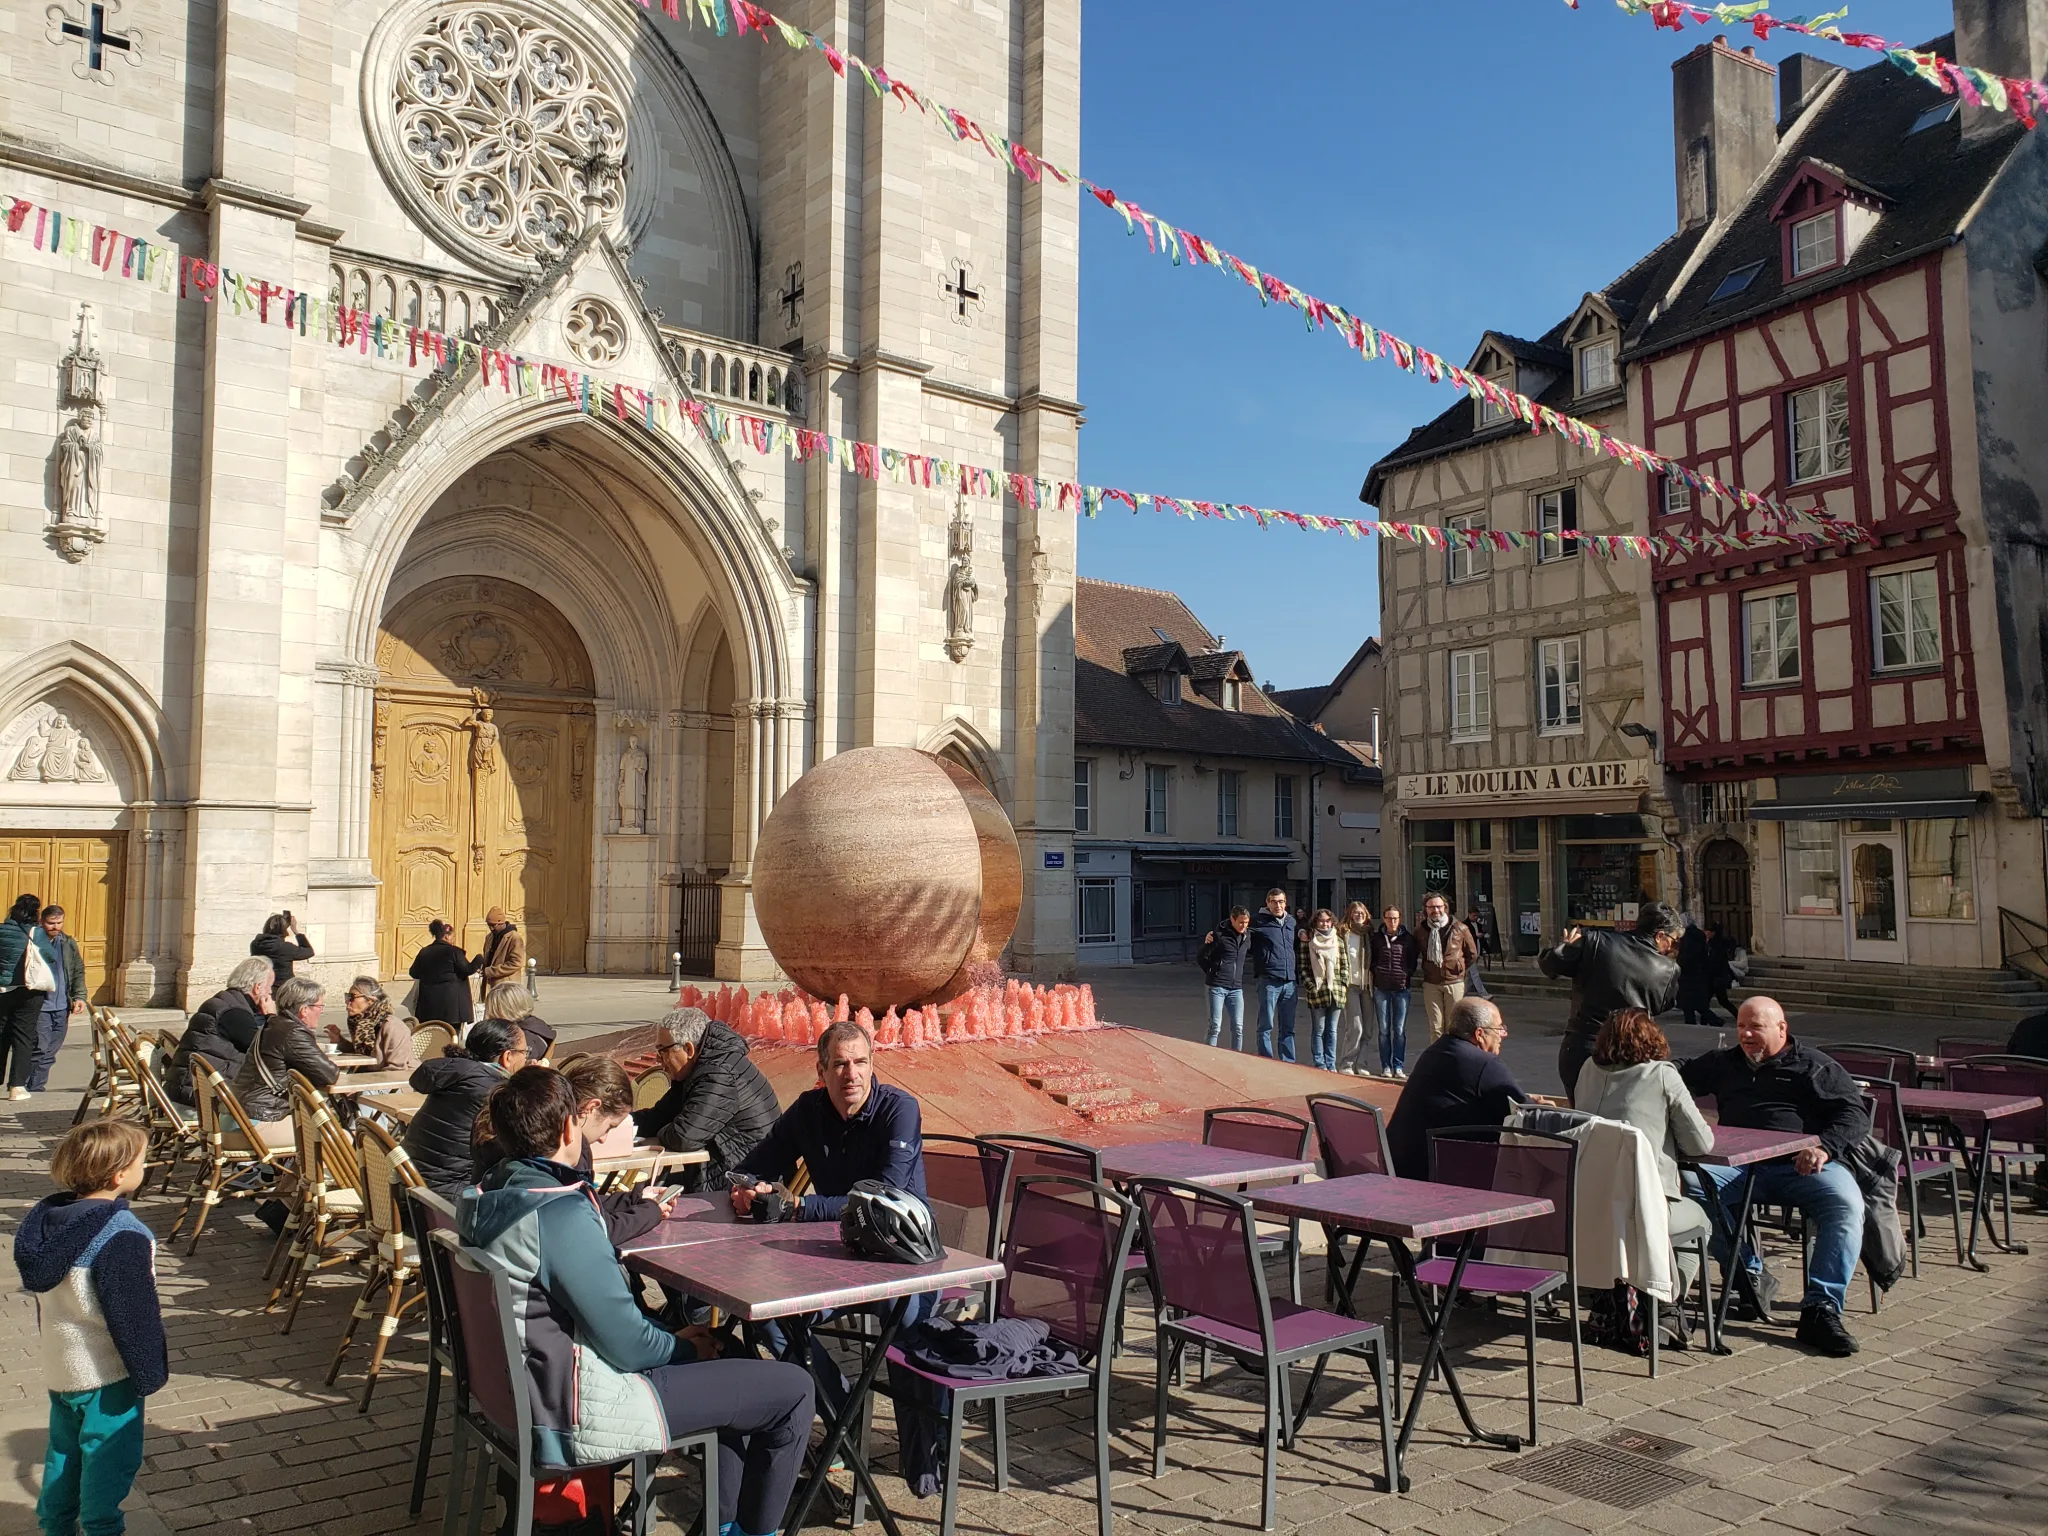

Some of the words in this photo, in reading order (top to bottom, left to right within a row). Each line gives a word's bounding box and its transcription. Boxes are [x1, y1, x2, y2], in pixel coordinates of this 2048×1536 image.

[1425, 776, 1449, 796] LE
[1455, 769, 1539, 794] MOULIN
[1546, 768, 1561, 789] A
[1567, 763, 1627, 788] CAFE
[1423, 869, 1449, 879] THE
[856, 1205, 867, 1228] uvex
